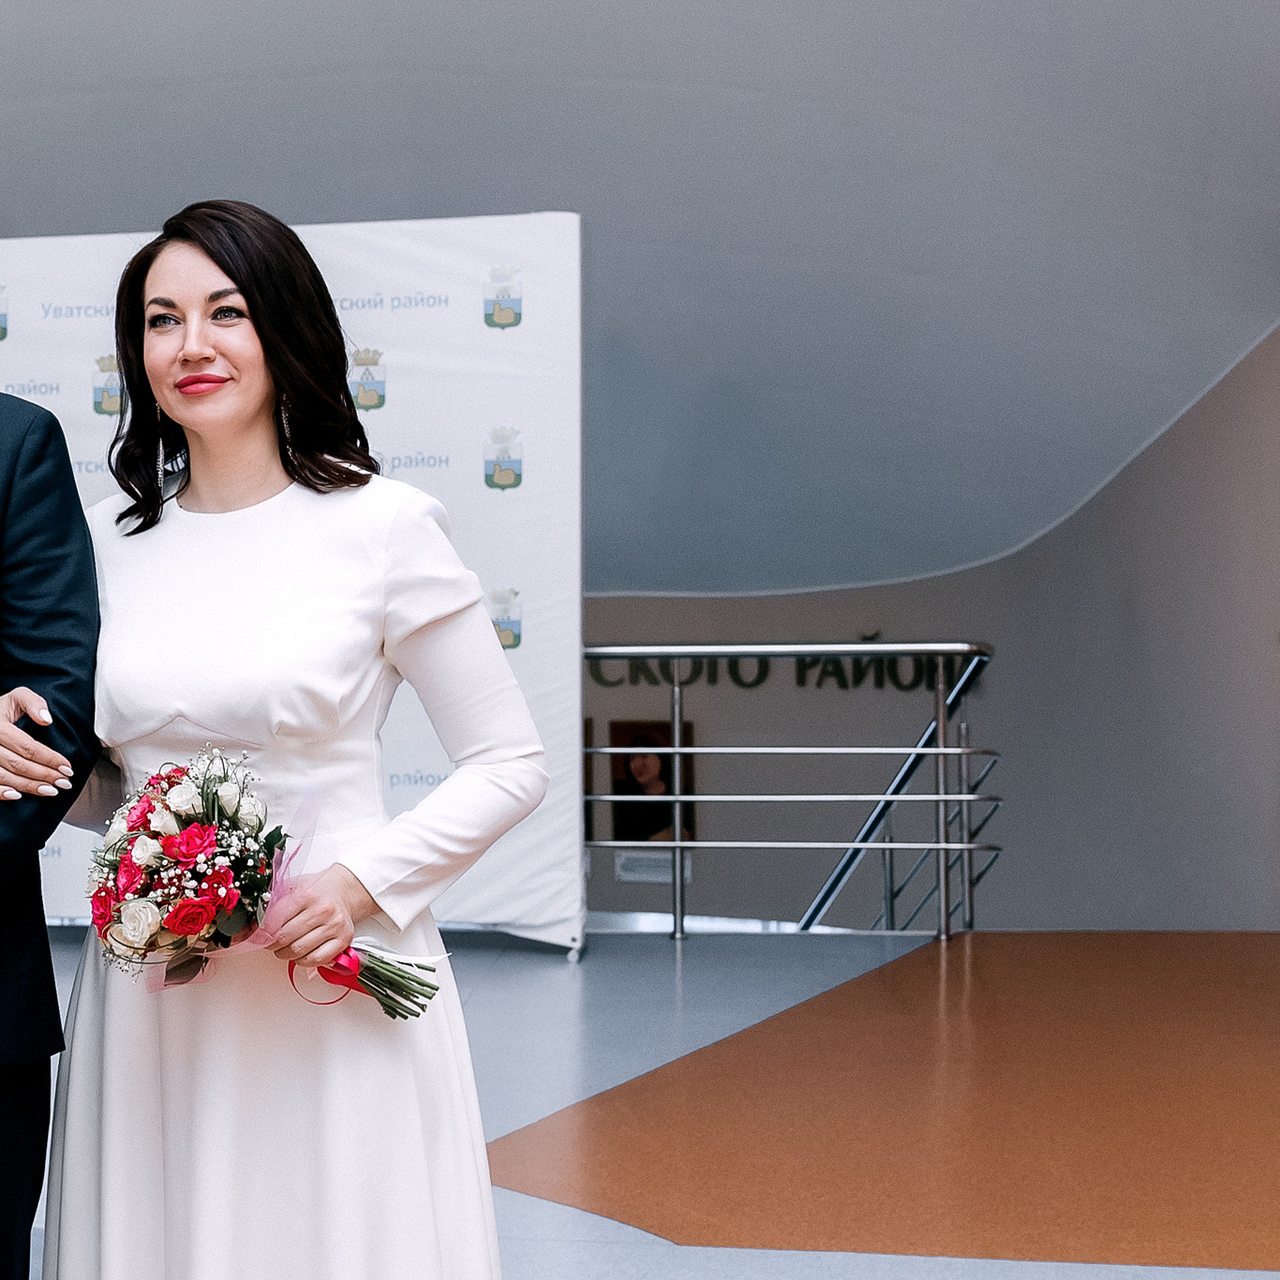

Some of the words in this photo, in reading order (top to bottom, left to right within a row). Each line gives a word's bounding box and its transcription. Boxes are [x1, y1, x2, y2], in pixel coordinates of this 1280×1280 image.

[40, 302, 115, 319] Уватски
[391, 290, 449, 313] район
[391, 451, 450, 473] район
